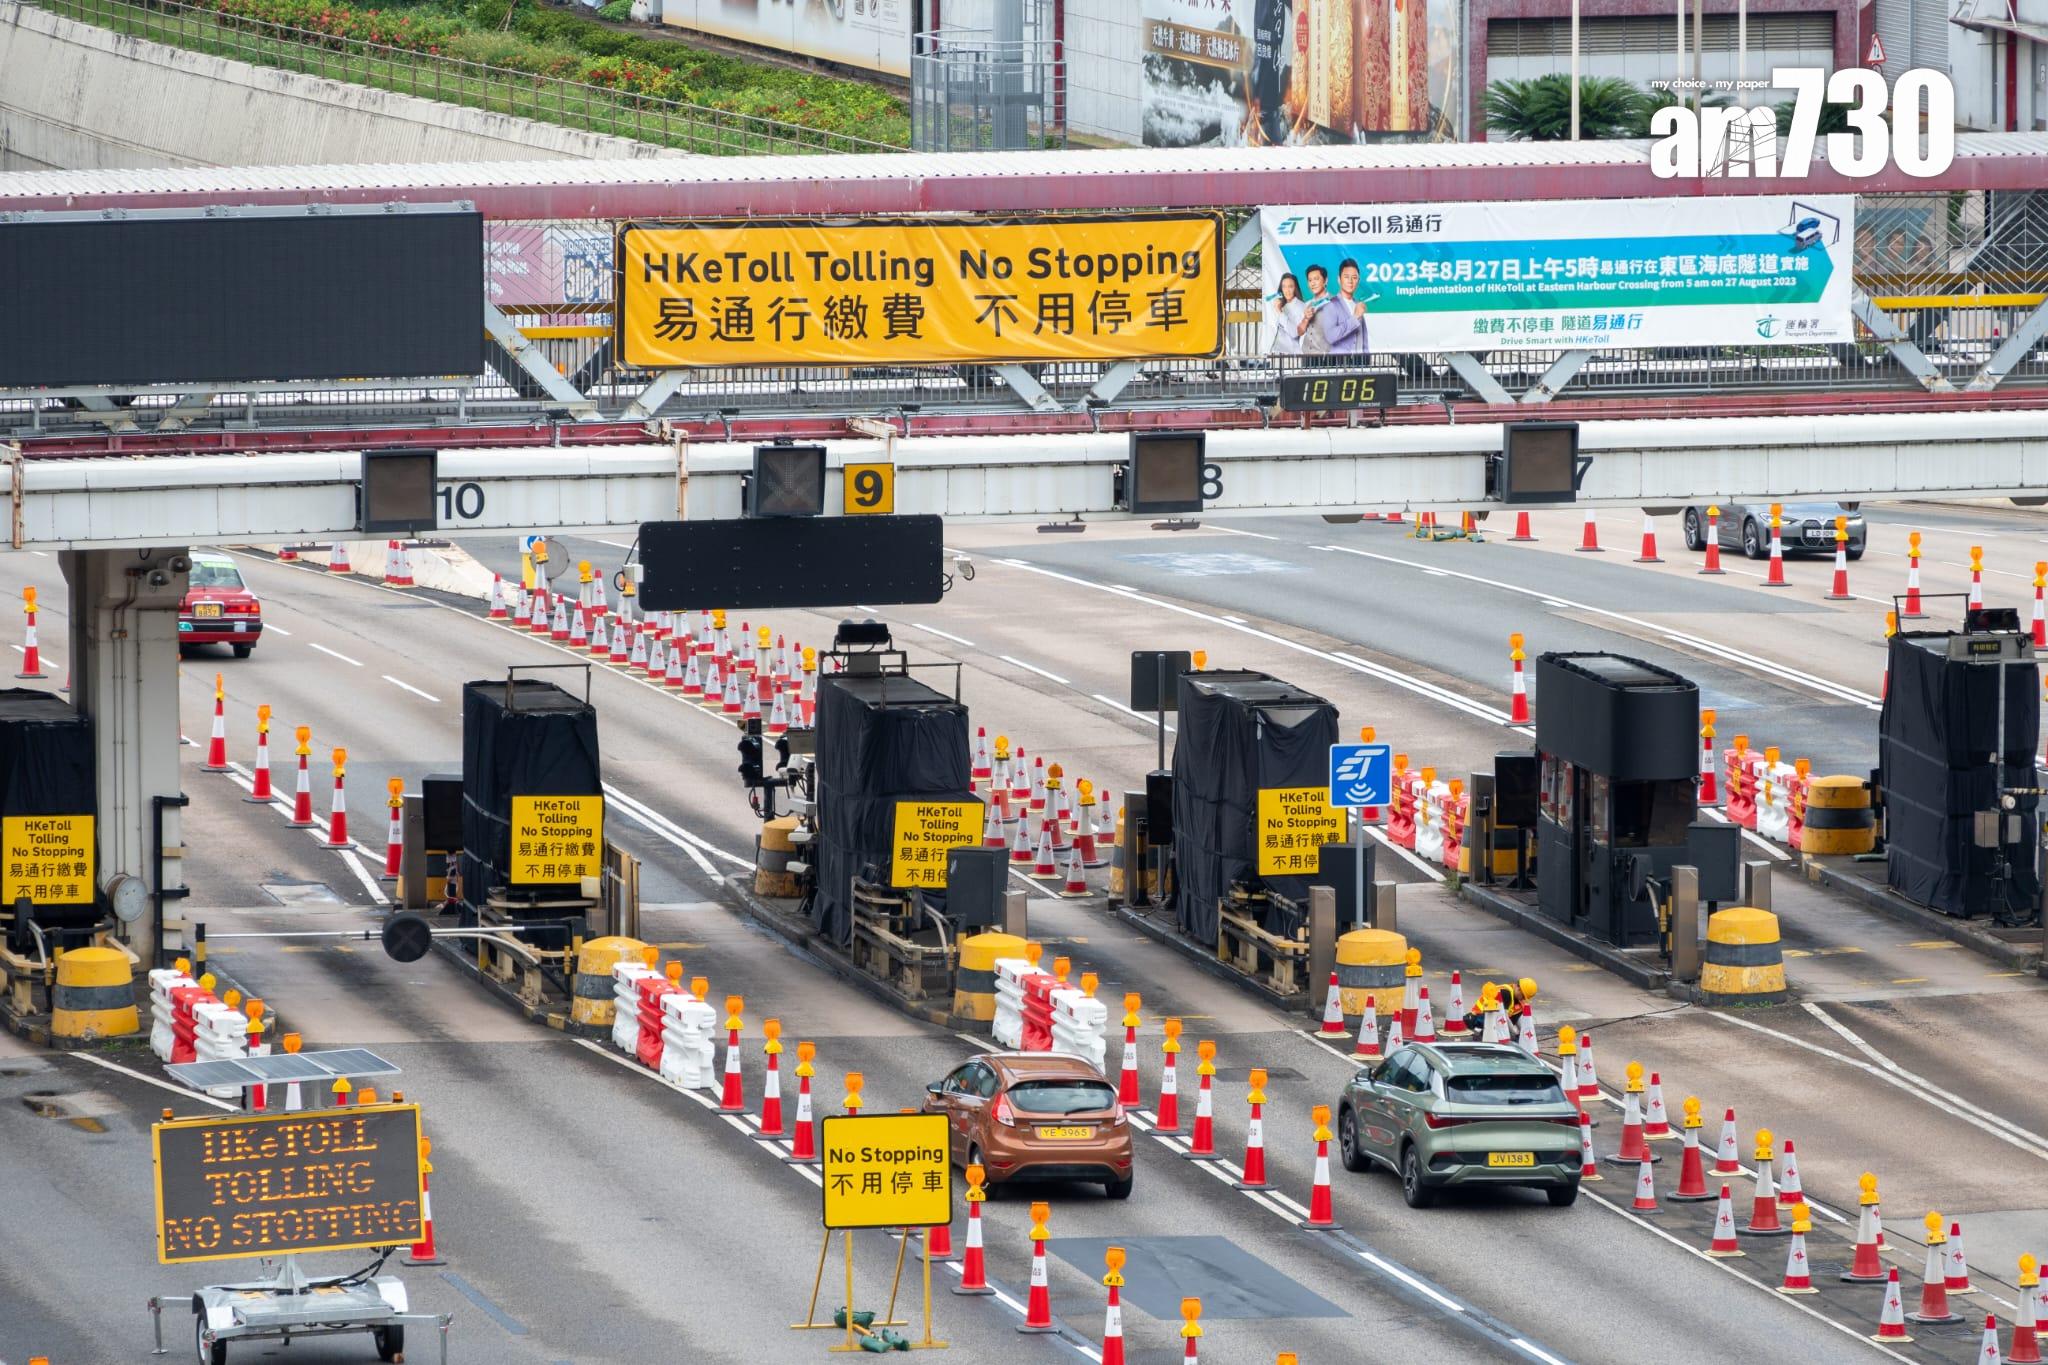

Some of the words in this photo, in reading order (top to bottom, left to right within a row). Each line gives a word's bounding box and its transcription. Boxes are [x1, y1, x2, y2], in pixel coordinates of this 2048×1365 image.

[1307, 215, 1382, 234] HKeToll
[1387, 214, 1443, 233] 易通行
[643, 252, 794, 283] HKeToll
[806, 250, 934, 287] Tolling
[959, 249, 1013, 279] No
[1027, 245, 1200, 283] Stopping
[1396, 284, 1473, 297] Implementation
[1475, 283, 1486, 293] of
[1488, 283, 1524, 293] HKeToll
[1527, 283, 1536, 292] at
[1538, 282, 1575, 292] Eastern
[1577, 280, 1616, 291] Harbour
[1618, 278, 1660, 291] Crossing
[1661, 277, 1685, 289] from
[1686, 278, 1693, 287] 5
[1694, 279, 1709, 288] am
[1710, 279, 1723, 288] on
[1725, 277, 1737, 287] 27
[1738, 277, 1772, 290] August
[1773, 276, 1797, 287] 2023
[653, 292, 925, 342] 易通行繳費
[974, 287, 1188, 337] 不用停車
[1473, 316, 1554, 334] 繳費不停車
[1501, 336, 1524, 345] Drive
[1526, 336, 1553, 345] Smart
[1554, 336, 1574, 345] with
[1575, 335, 1610, 345] HKeToll
[1576, 456, 1594, 490] 7
[854, 469, 884, 507] 9
[1201, 463, 1224, 500] 8
[437, 482, 485, 520] 10
[1279, 792, 1325, 803] HKeToll
[534, 801, 580, 811] HKeToll
[917, 807, 962, 817] HKeToll
[1283, 805, 1322, 816] Tolling
[25, 821, 72, 831] HKeToll
[538, 813, 577, 825] Tolling
[920, 819, 959, 831] Tolling
[1267, 819, 1283, 829] No
[1287, 817, 1337, 829] Stopping
[28, 834, 69, 844] Tolling
[521, 826, 537, 836] No
[541, 826, 593, 838] Stopping
[903, 832, 919, 841] No
[923, 832, 973, 843] Stopping
[12, 847, 28, 856] No
[33, 847, 84, 858] Stopping
[519, 842, 596, 857] 易通行繳費
[900, 847, 945, 862] 易通行
[1273, 854, 1318, 869] 不用停
[10, 862, 87, 878] 易通行繳費
[526, 863, 587, 878] 不用停車
[17, 884, 79, 898] 不用停車
[829, 1148, 856, 1163] No
[861, 1146, 943, 1164] Stopping
[205, 1161, 375, 1205] TOLLING
[830, 1170, 944, 1196] 不用停車
[165, 1215, 221, 1251] NO
